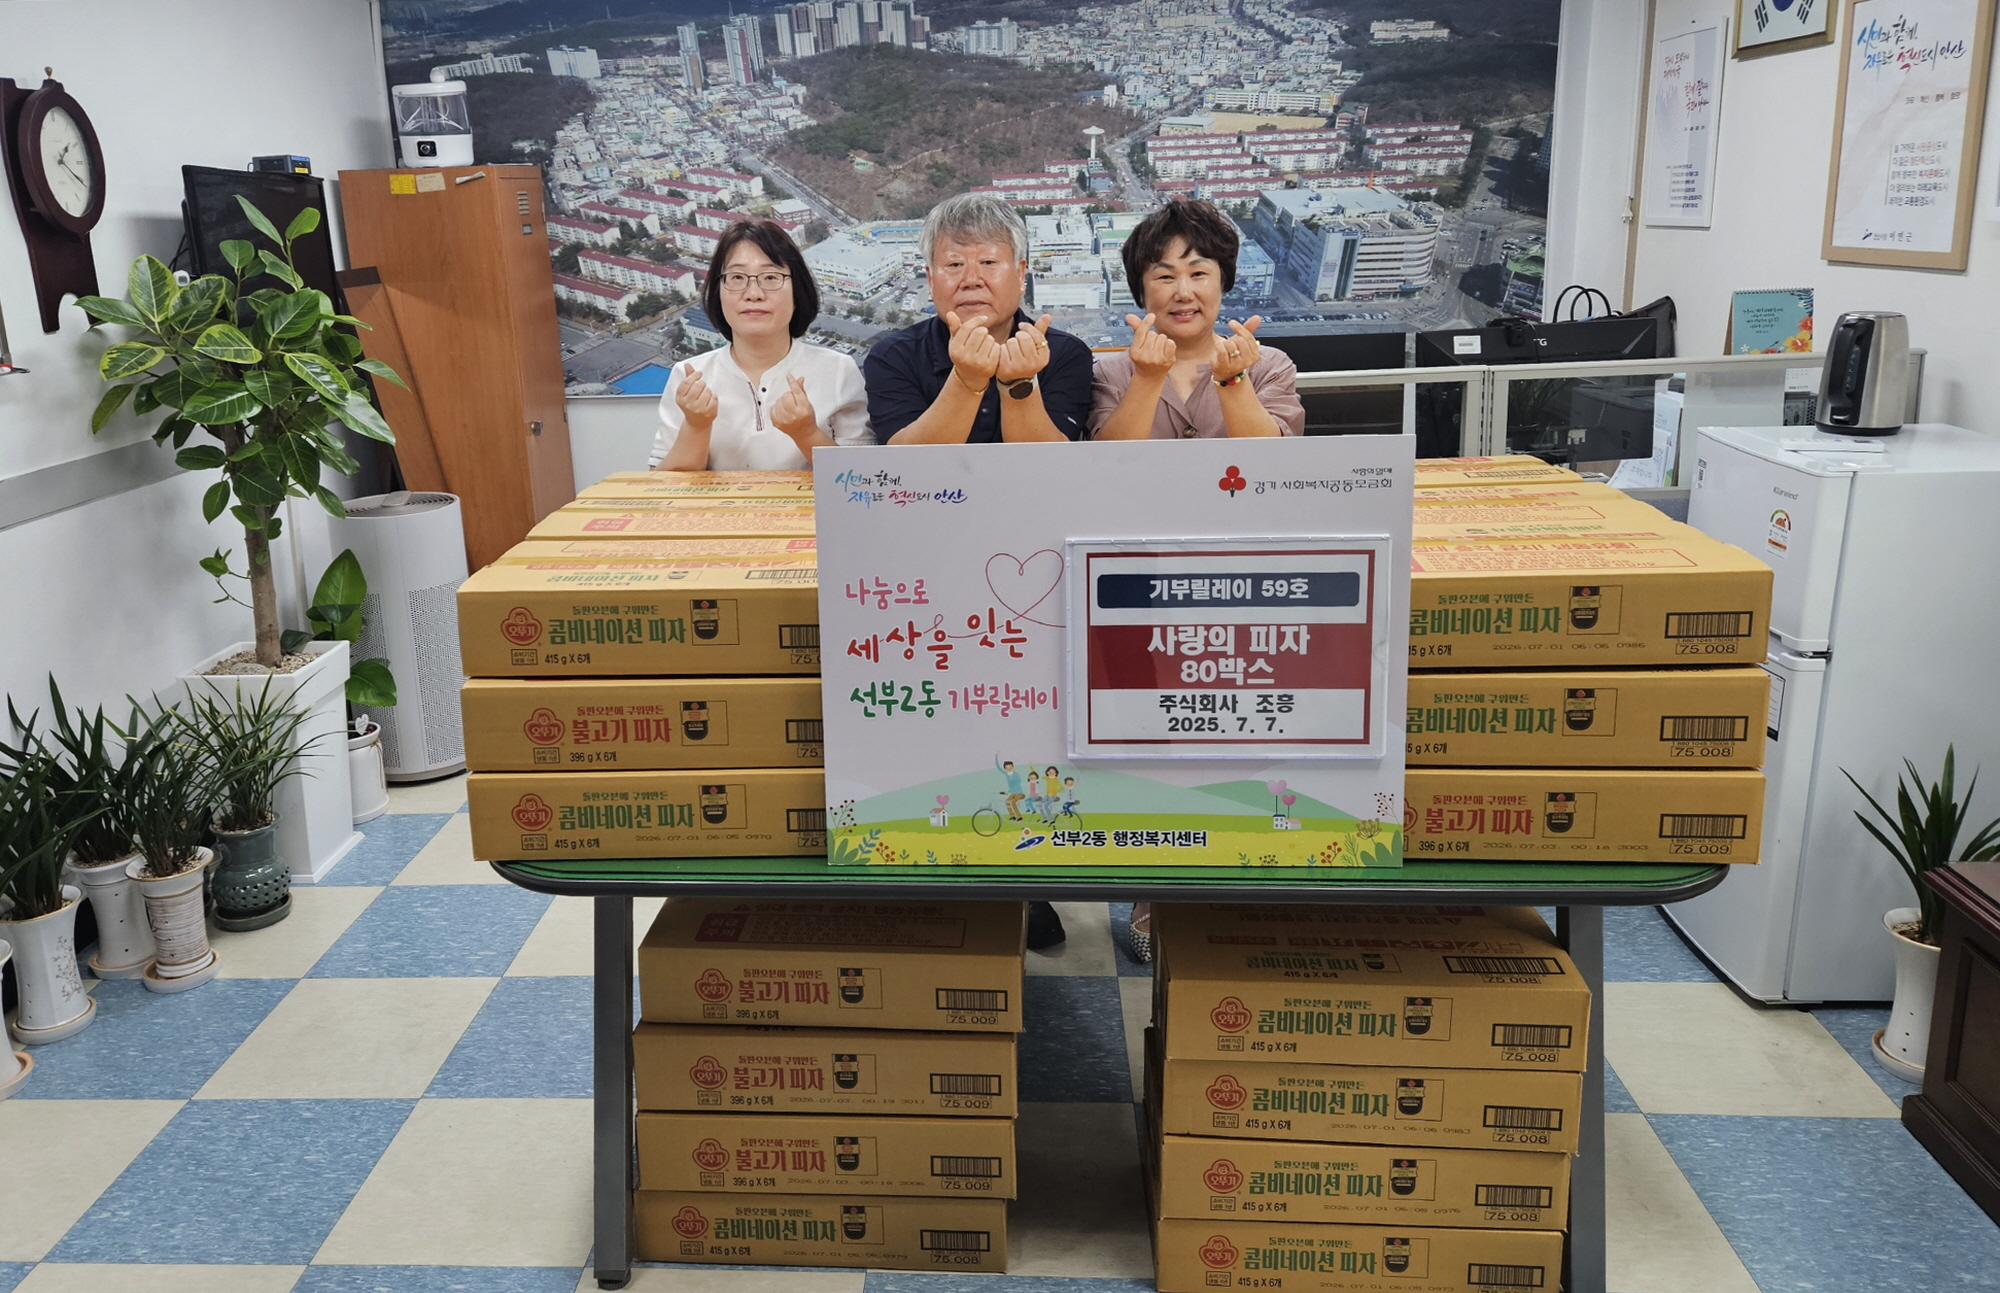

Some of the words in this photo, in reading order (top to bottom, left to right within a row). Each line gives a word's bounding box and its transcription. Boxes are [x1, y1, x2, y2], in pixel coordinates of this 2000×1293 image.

[1940, 40, 1967, 59] 안산
[835, 470, 873, 492] 시민과
[1253, 481, 1276, 494] 경기
[1280, 478, 1392, 492] 사회복지공동모금회
[848, 491, 884, 509] 자유로운
[888, 490, 930, 507] 혁신도시
[934, 489, 968, 503] 안산
[846, 576, 930, 610] 나눔으로
[1149, 578, 1252, 600] 기부릴레이
[1261, 578, 1310, 600] 59호
[548, 618, 644, 644] 콤비네이션
[648, 618, 686, 644] 피자
[1408, 607, 1512, 635] 콤비네이션
[1518, 606, 1562, 634] 피자
[847, 620, 953, 670] 세상을
[967, 607, 1028, 658] 잇는
[1147, 625, 1236, 656] 사랑의
[1249, 624, 1310, 655] 피자
[1680, 644, 1700, 654] 75
[1706, 644, 1736, 653] 008
[544, 654, 558, 664] 415
[562, 656, 566, 664] g
[569, 654, 576, 664] X
[578, 653, 590, 664] 6개
[1180, 658, 1275, 686] 80박스
[850, 680, 942, 718] 선부2동
[948, 682, 1058, 718] 기부릴레이
[1159, 694, 1238, 714] 주식회사
[1256, 694, 1295, 714] 조흥
[572, 718, 628, 744] 불고기
[634, 718, 672, 743] 피자
[1168, 717, 1226, 734] 2025.
[1236, 717, 1255, 734] 7.
[1265, 717, 1284, 734] 7.
[1406, 708, 1508, 734] 콤비네이션
[1515, 708, 1556, 734] 피자
[570, 752, 585, 762] 396
[588, 754, 592, 762] g
[596, 752, 601, 762] X
[604, 751, 616, 762] 6개
[1674, 748, 1694, 756] 75
[1700, 748, 1732, 756] 008
[559, 805, 652, 830] 콤비네이션
[657, 804, 695, 828] 피자
[1424, 808, 1484, 834] 불고기
[1490, 809, 1533, 835] 피자
[554, 839, 568, 848] 415
[571, 840, 576, 849] g
[578, 838, 584, 848] X
[587, 838, 600, 848] 6개
[1050, 830, 1107, 847] 선부2동
[1113, 830, 1208, 847] 행정복지센터
[1674, 844, 1694, 854] 75
[1699, 844, 1730, 854] 009
[738, 980, 790, 1004] 불고기
[794, 982, 830, 1004] 피자
[950, 1016, 966, 1024] 75
[970, 1016, 996, 1024] 009
[1257, 1010, 1352, 1036] 콤비네이션
[1358, 1012, 1397, 1038] 피자
[1506, 1052, 1523, 1060] 75
[1528, 1053, 1556, 1062] 008
[733, 1066, 784, 1090] 불고기
[789, 1068, 824, 1090] 피자
[944, 1100, 958, 1108] 75
[964, 1100, 990, 1108] 009
[1252, 1088, 1346, 1115] 콤비네이션
[1352, 1092, 1389, 1116] 피자
[1497, 1134, 1514, 1142] 75
[1520, 1135, 1548, 1143] 008
[735, 1149, 787, 1172] 불고기
[792, 1150, 826, 1172] 피자
[944, 1181, 961, 1190] 75
[965, 1182, 990, 1190] 009
[1248, 1172, 1340, 1196] 콤비네이션
[1346, 1174, 1383, 1197] 피자
[1488, 1212, 1506, 1220] 75
[1510, 1212, 1538, 1220] 008
[713, 1218, 798, 1240] 콤비네이션
[802, 1220, 837, 1242] 피자
[934, 1255, 950, 1263] 75
[954, 1256, 979, 1264] 008
[1244, 1247, 1336, 1273] 콤비네이션
[1340, 1250, 1377, 1274] 피자
